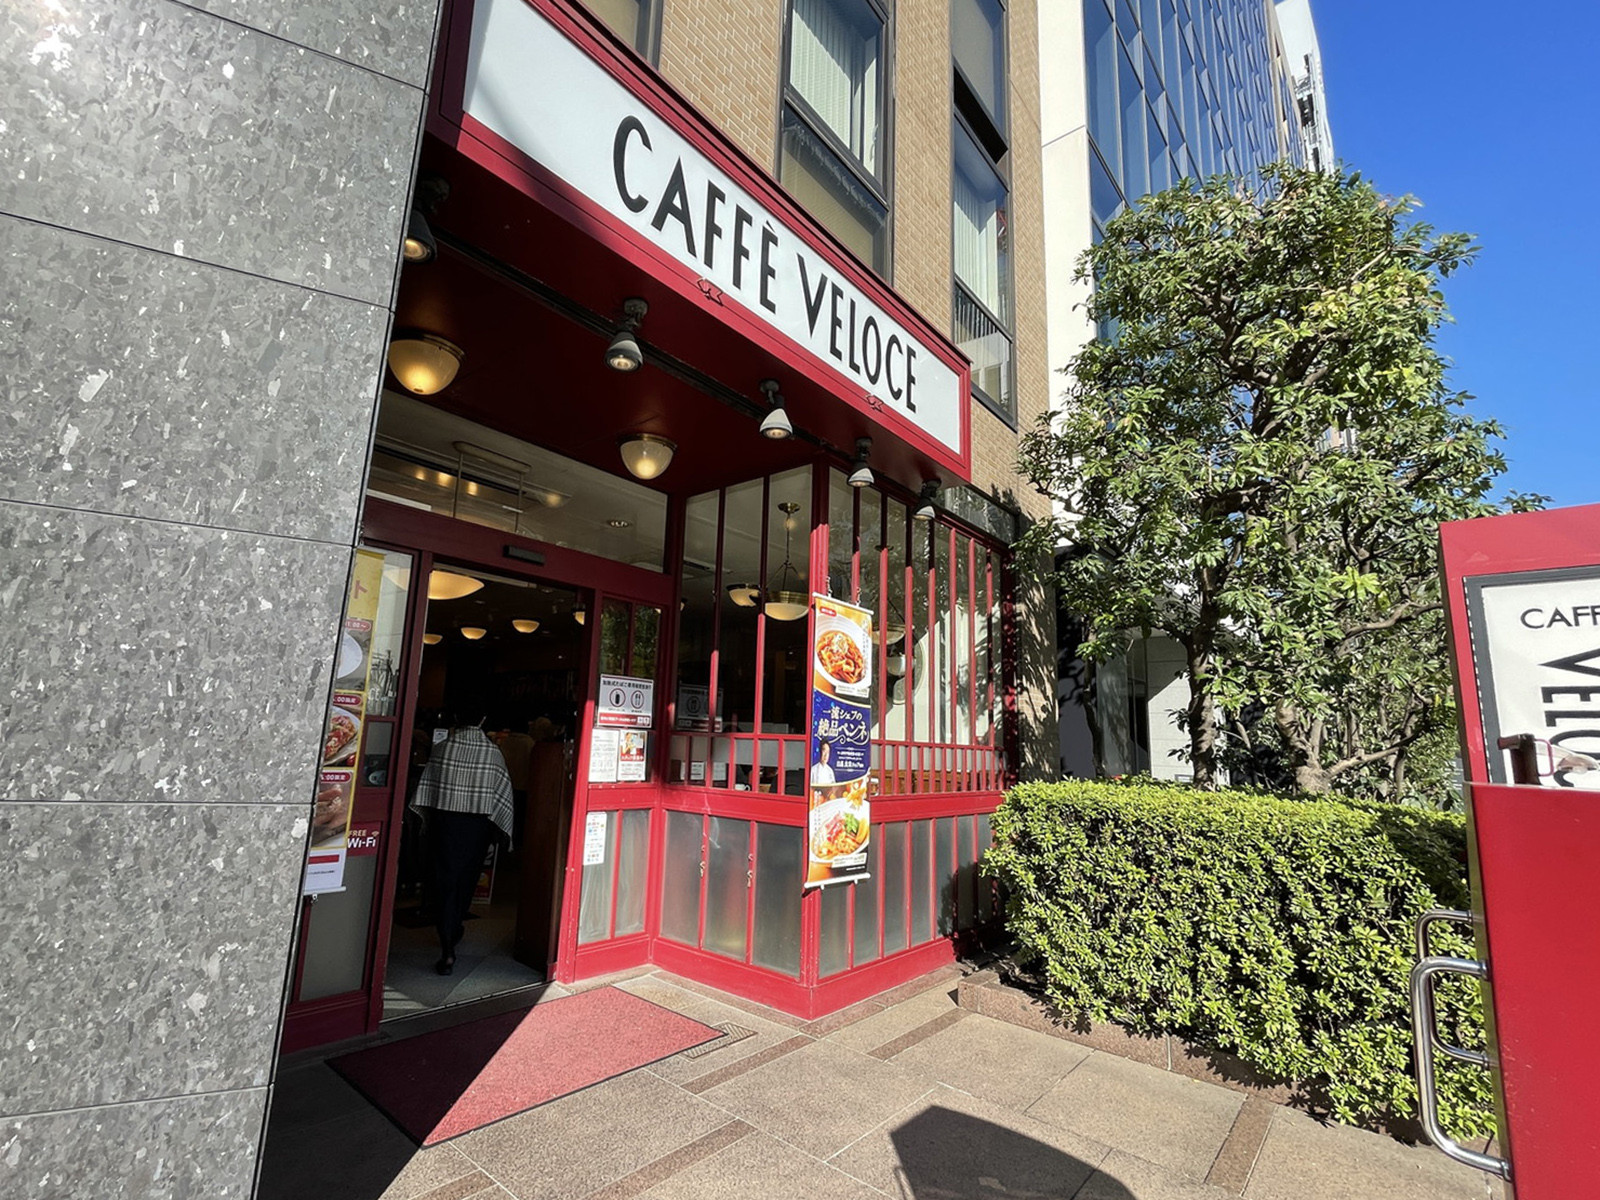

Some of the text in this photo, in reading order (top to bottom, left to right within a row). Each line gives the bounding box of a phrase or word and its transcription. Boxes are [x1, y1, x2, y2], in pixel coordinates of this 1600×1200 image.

[612, 115, 917, 414] CAFFÈ VELOCE
[349, 829, 367, 837] FREE
